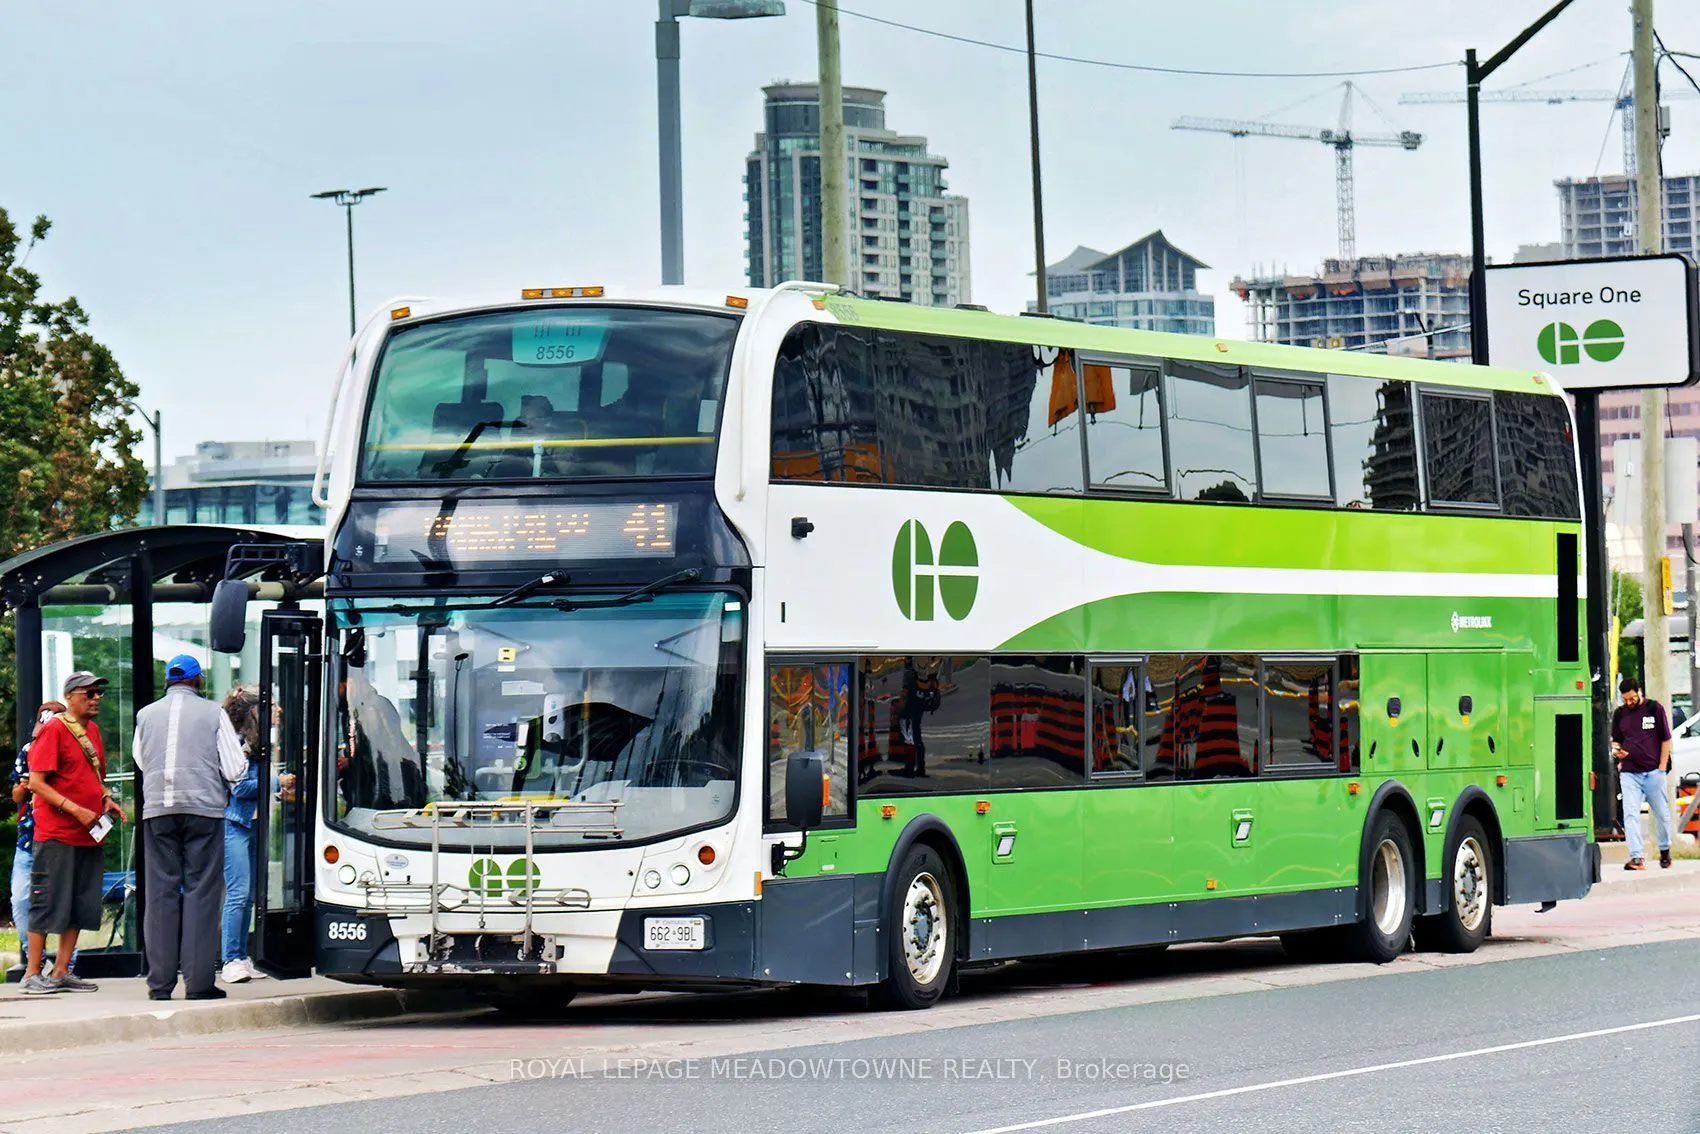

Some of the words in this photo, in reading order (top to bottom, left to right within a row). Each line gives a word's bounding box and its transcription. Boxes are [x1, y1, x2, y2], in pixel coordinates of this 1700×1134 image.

[1518, 289, 1593, 309] Square
[1600, 286, 1641, 303] One
[536, 345, 575, 360] 8556
[1537, 319, 1625, 365] GO
[622, 504, 672, 547] 41
[892, 518, 979, 621] GO
[328, 922, 367, 941] 8556
[650, 926, 670, 941] 662
[677, 926, 697, 941] 9BL
